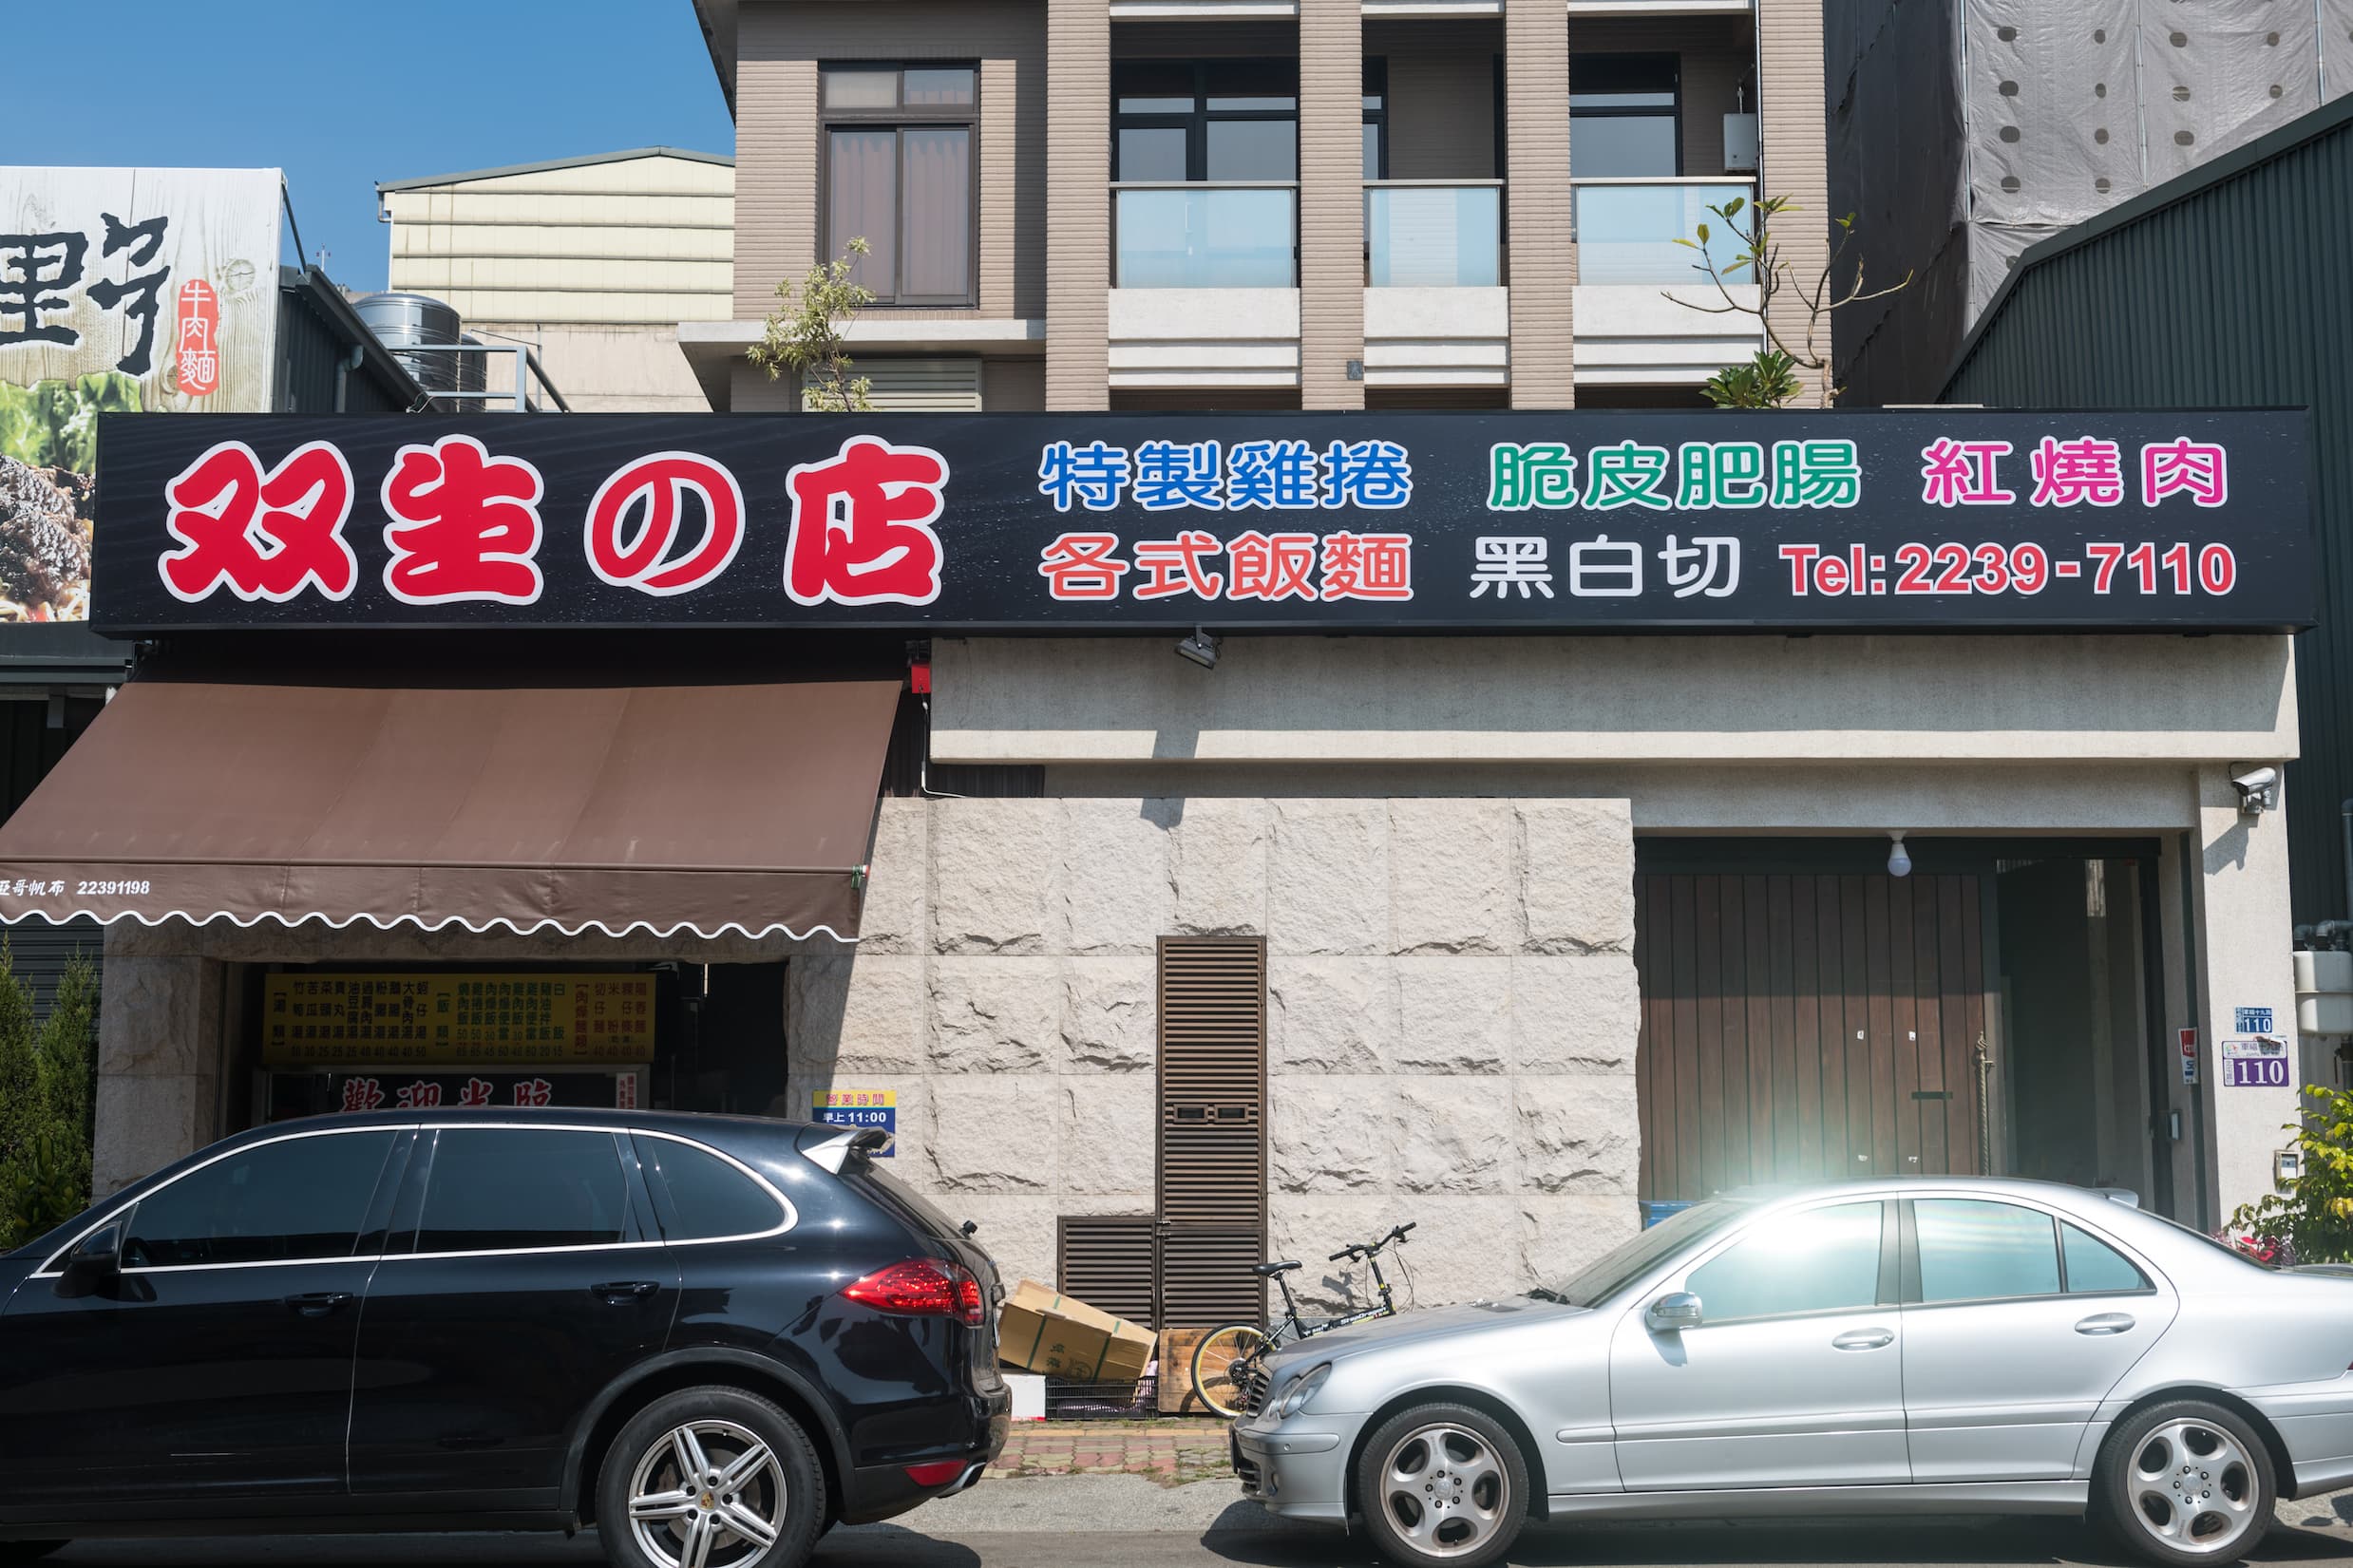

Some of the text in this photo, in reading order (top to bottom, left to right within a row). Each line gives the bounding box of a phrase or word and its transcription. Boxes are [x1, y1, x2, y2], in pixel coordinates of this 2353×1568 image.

[180, 281, 217, 390] 牛肉麵
[1038, 440, 1414, 512] 特製雞捲
[1487, 439, 1863, 510] 脆皮肥腸
[1922, 435, 2229, 508] 紅燒肉
[158, 433, 951, 606] 双生の店
[1038, 529, 1414, 601] 各式飯麵
[1470, 534, 1740, 598] 黑白切
[77, 880, 150, 896] 22391198
[2245, 1018, 2271, 1032] 110
[2237, 1060, 2284, 1085] 110
[823, 1112, 886, 1123] 早上 11:00
